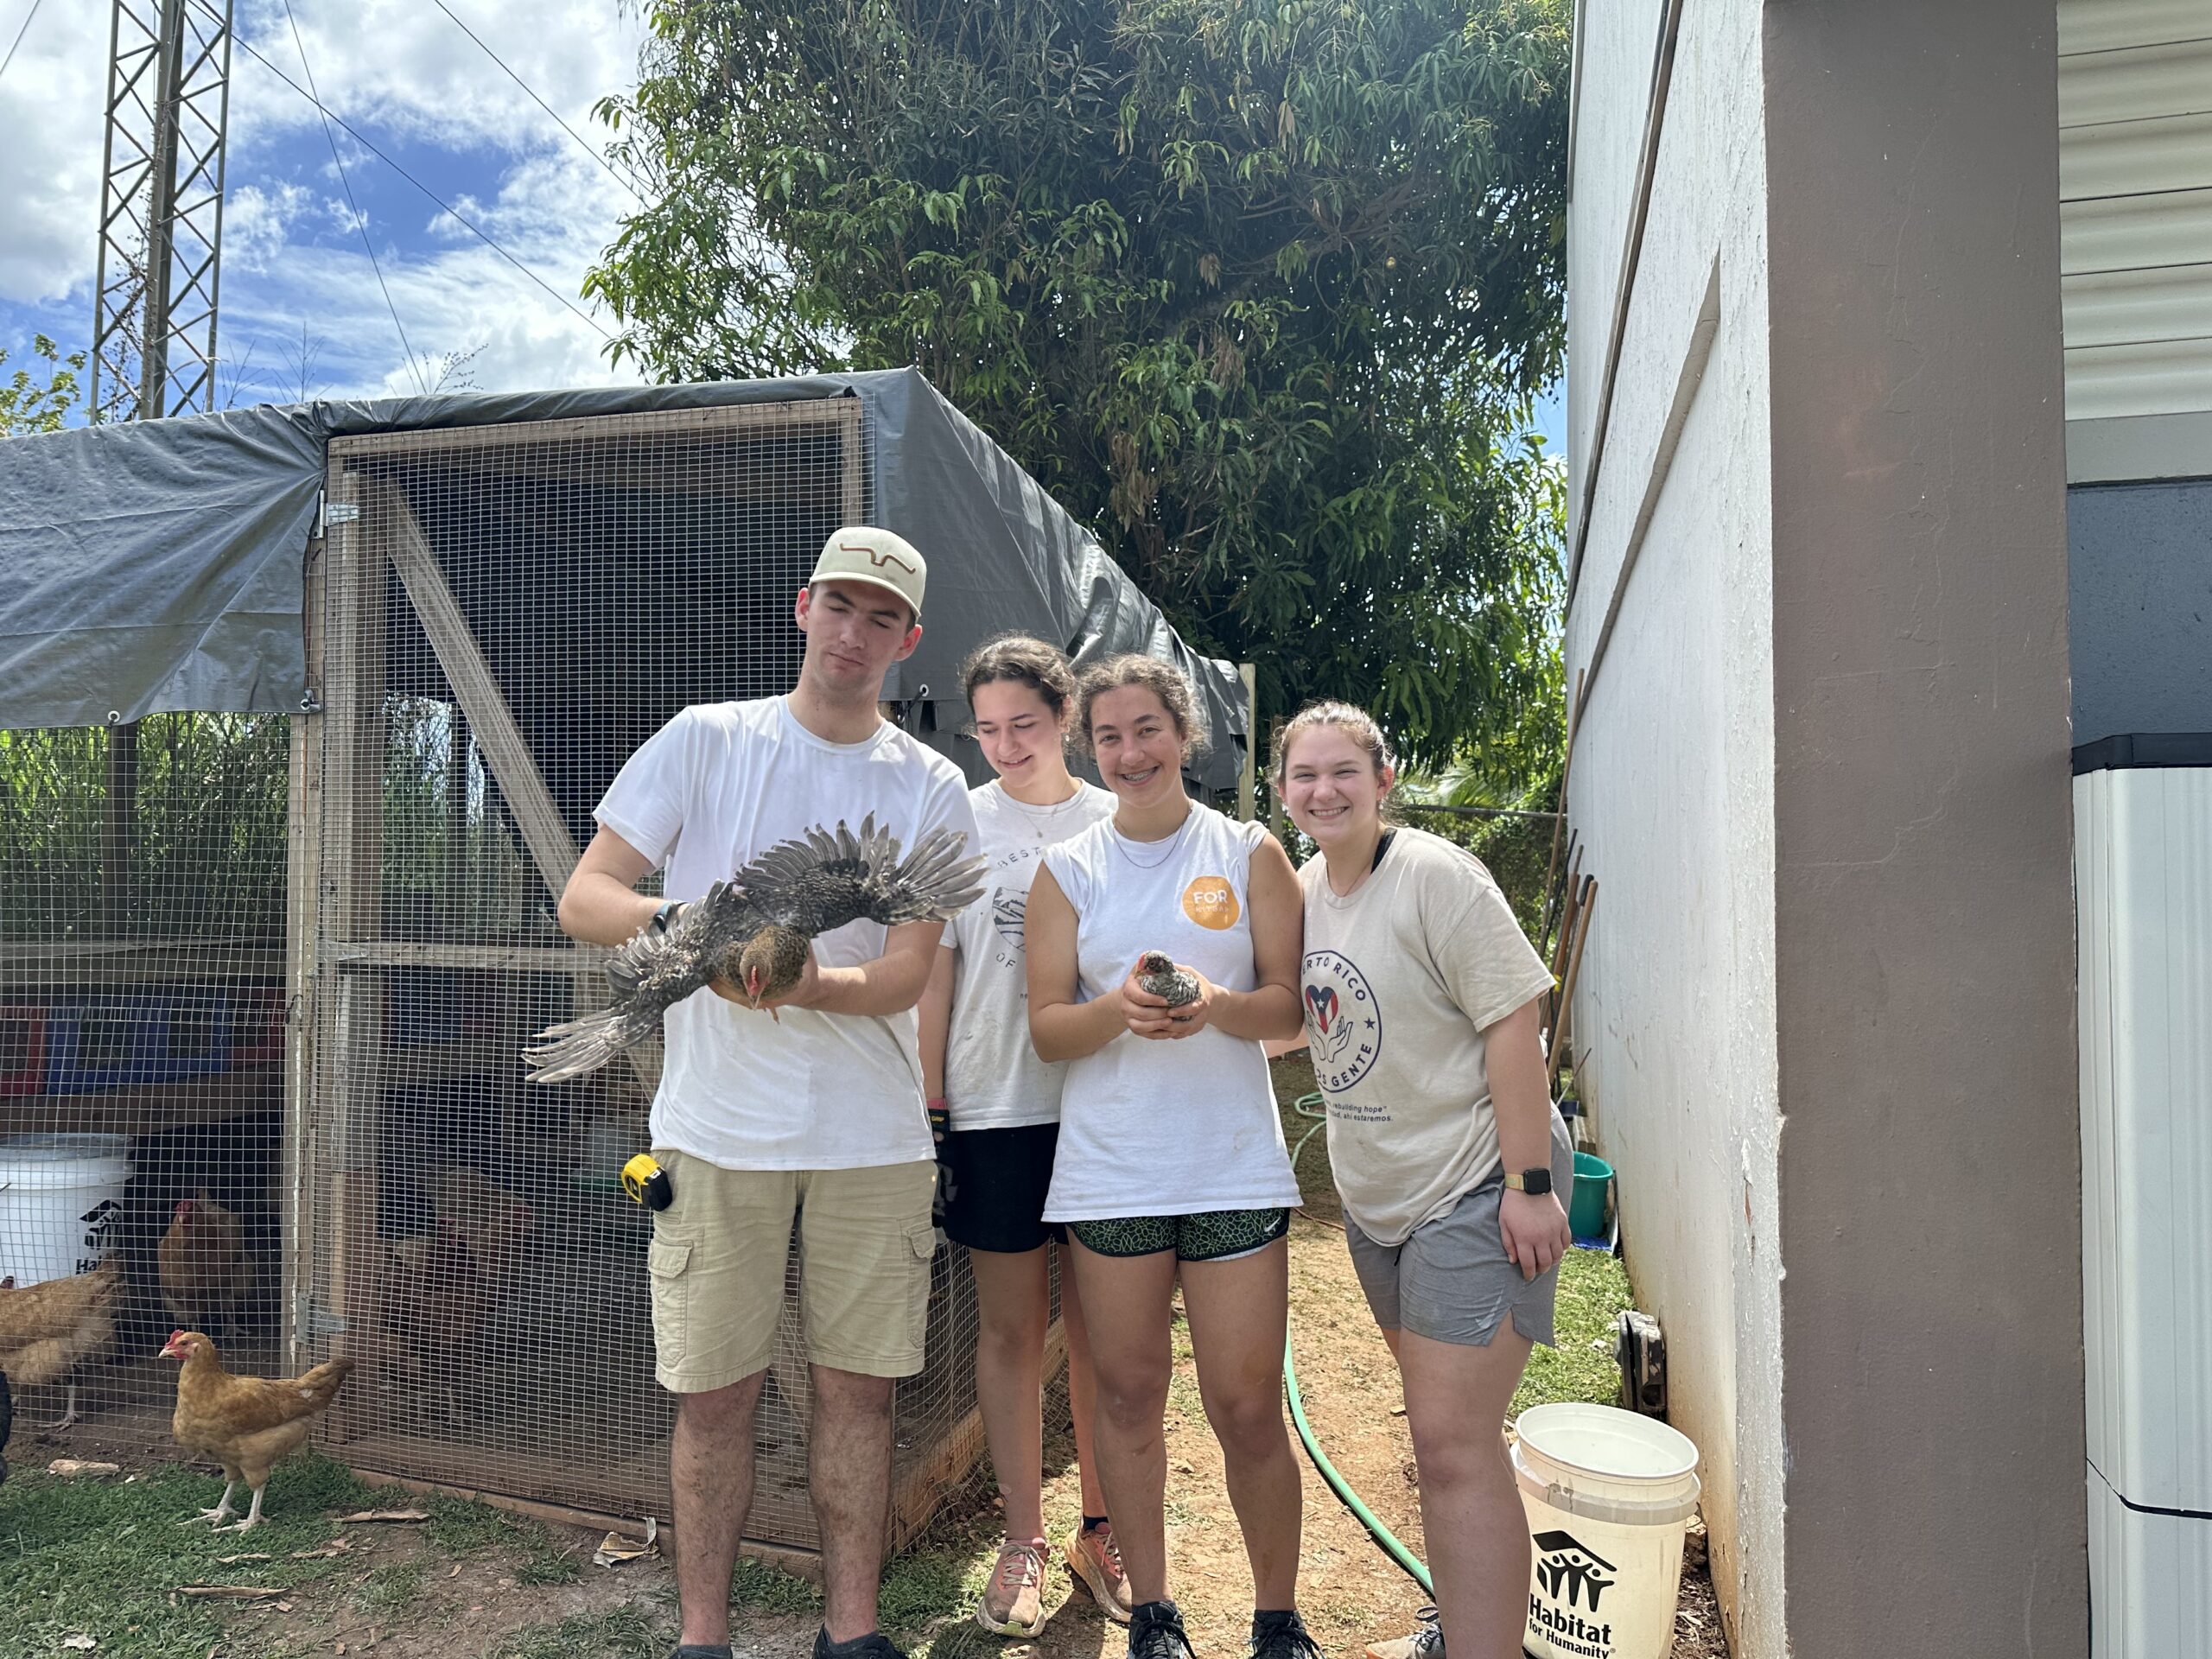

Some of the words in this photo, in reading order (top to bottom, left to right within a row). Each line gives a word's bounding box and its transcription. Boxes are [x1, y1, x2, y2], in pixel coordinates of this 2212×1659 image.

[1193, 889, 1228, 905] FOR
[995, 952, 1016, 968] OF
[1333, 962, 1366, 1001] RICO
[1331, 1044, 1372, 1087] GENTE
[1529, 1592, 1611, 1645] Habitat
[1529, 1618, 1542, 1637] for
[1546, 1629, 1610, 1659] Humanity
